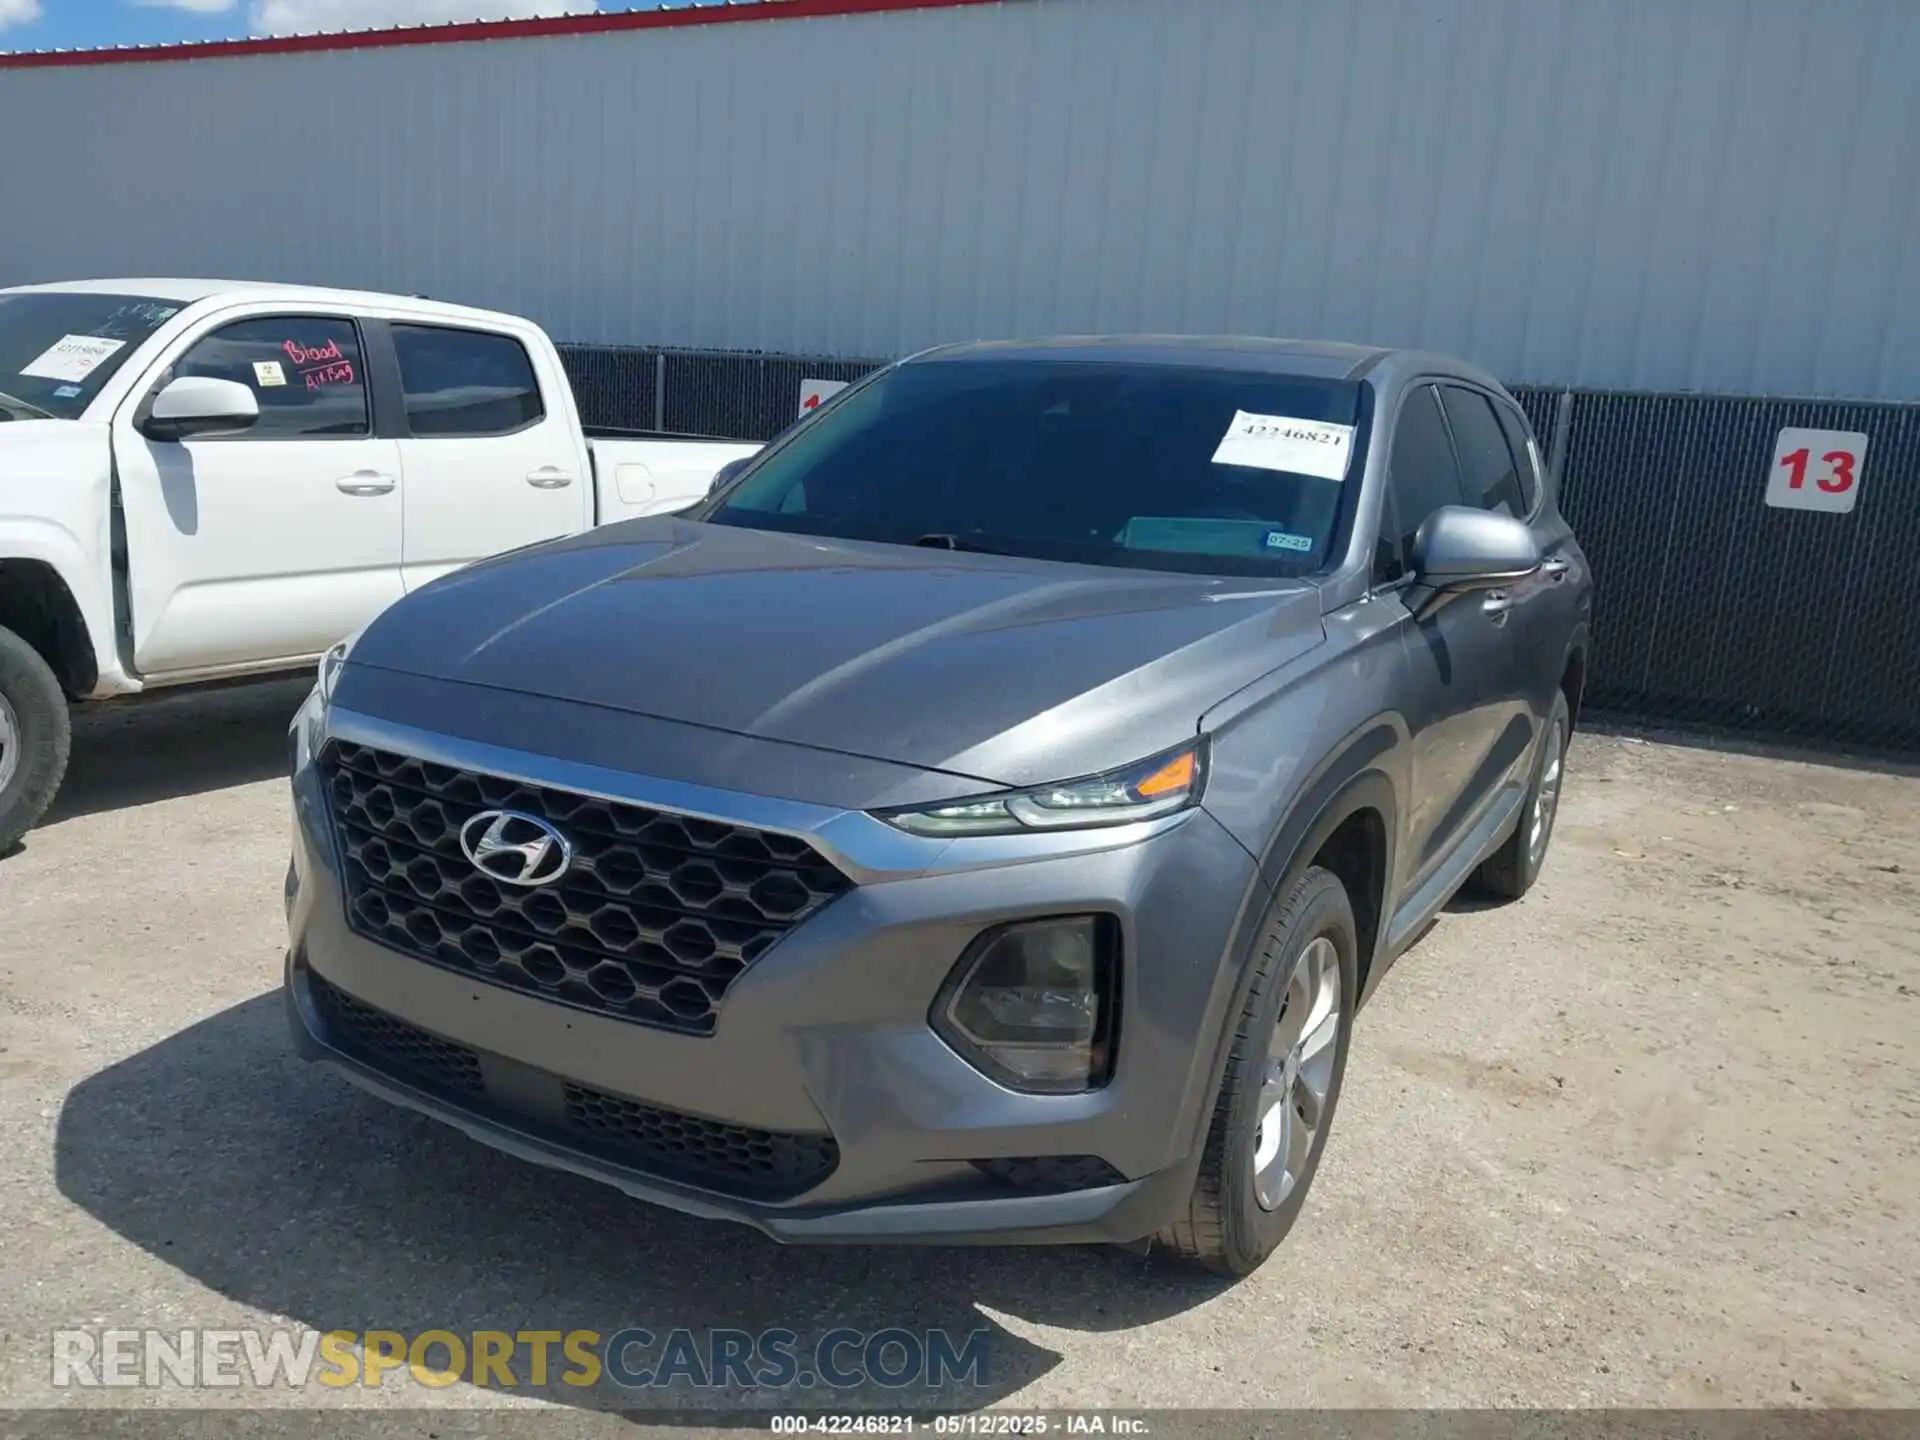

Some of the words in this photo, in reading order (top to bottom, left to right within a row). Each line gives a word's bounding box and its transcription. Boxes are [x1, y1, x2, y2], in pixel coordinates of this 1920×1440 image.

[282, 338, 342, 363] Blood
[1242, 424, 1341, 446] 42246821
[1780, 448, 1855, 493] 13
